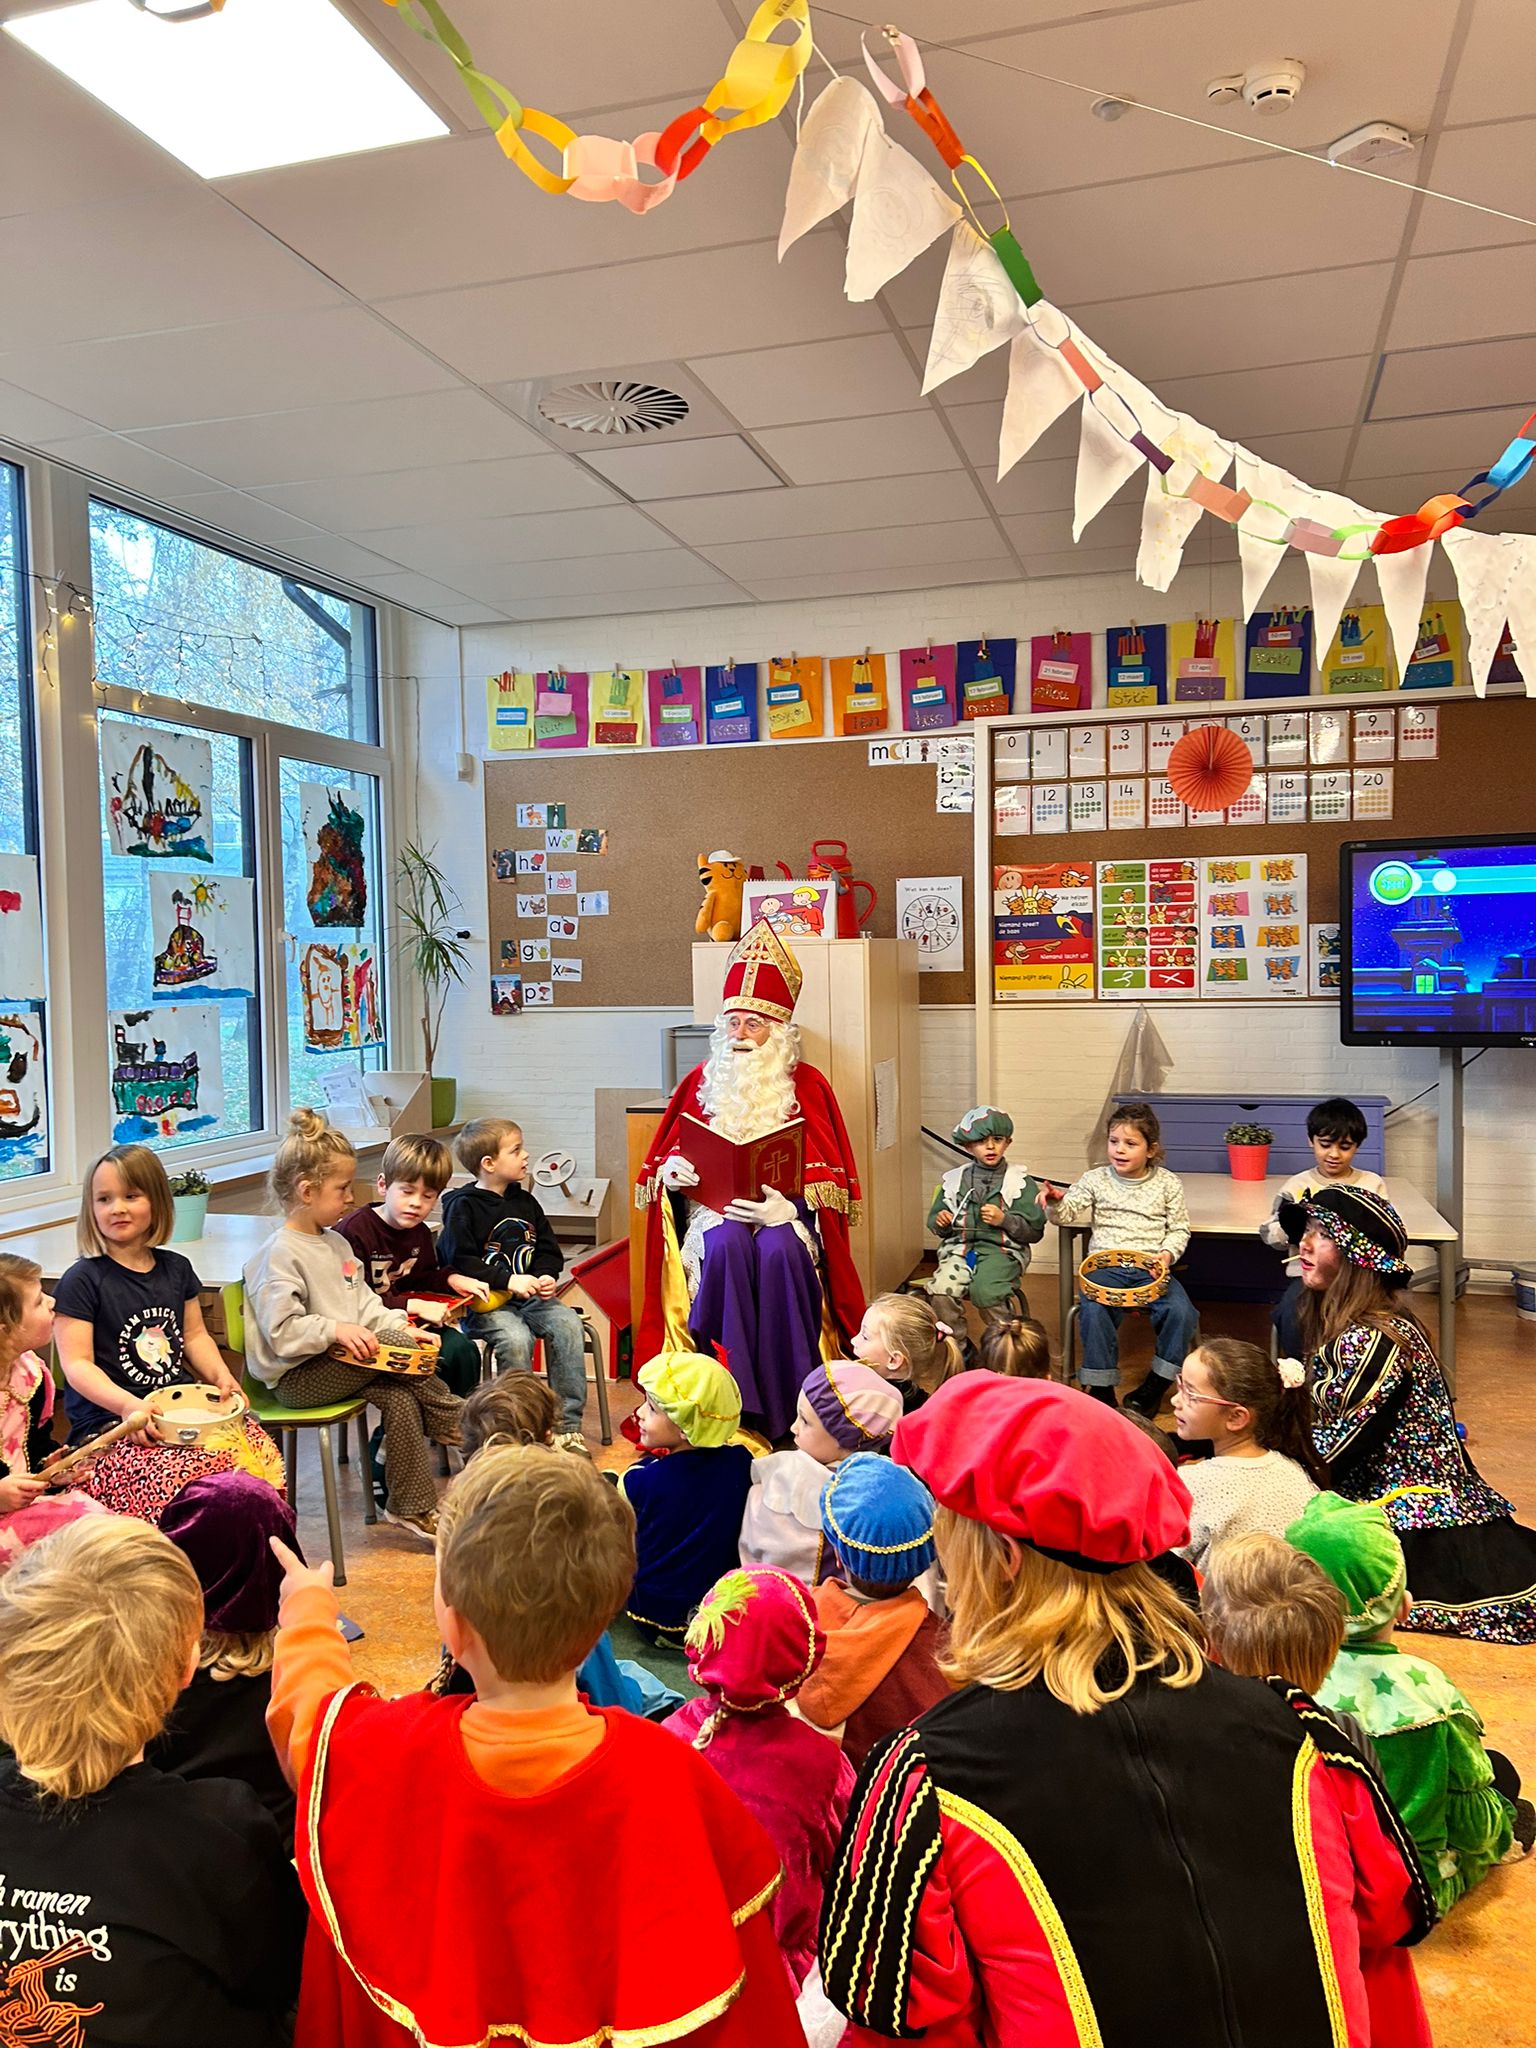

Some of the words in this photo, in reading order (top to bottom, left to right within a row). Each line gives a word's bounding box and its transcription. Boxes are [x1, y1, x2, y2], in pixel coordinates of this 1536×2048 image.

[1283, 718, 1292, 731] 7
[1367, 714, 1378, 727] 9
[1161, 726, 1171, 738] 4
[1241, 721, 1250, 734] 6
[1083, 732, 1092, 744] 2
[1121, 729, 1130, 741] 3
[1007, 736, 1017, 748] 0
[871, 746, 889, 760] m
[1280, 778, 1295, 789] 18
[1323, 776, 1338, 788] 19
[1363, 773, 1384, 786] 20
[1081, 787, 1095, 799] 13
[1119, 784, 1134, 796] 14
[1160, 782, 1174, 794] 15
[1043, 789, 1056, 801] 12
[548, 836, 561, 847] w
[519, 855, 529, 870] h
[548, 875, 553, 889] t
[519, 901, 528, 912] v
[580, 896, 586, 911] f
[550, 920, 560, 932] a
[523, 945, 534, 960] g
[553, 964, 562, 976] x
[525, 987, 536, 1002] p
[119, 1314, 141, 1345] TEAM
[11, 1888, 91, 1916] ramen
[55, 1967, 78, 1991] is
